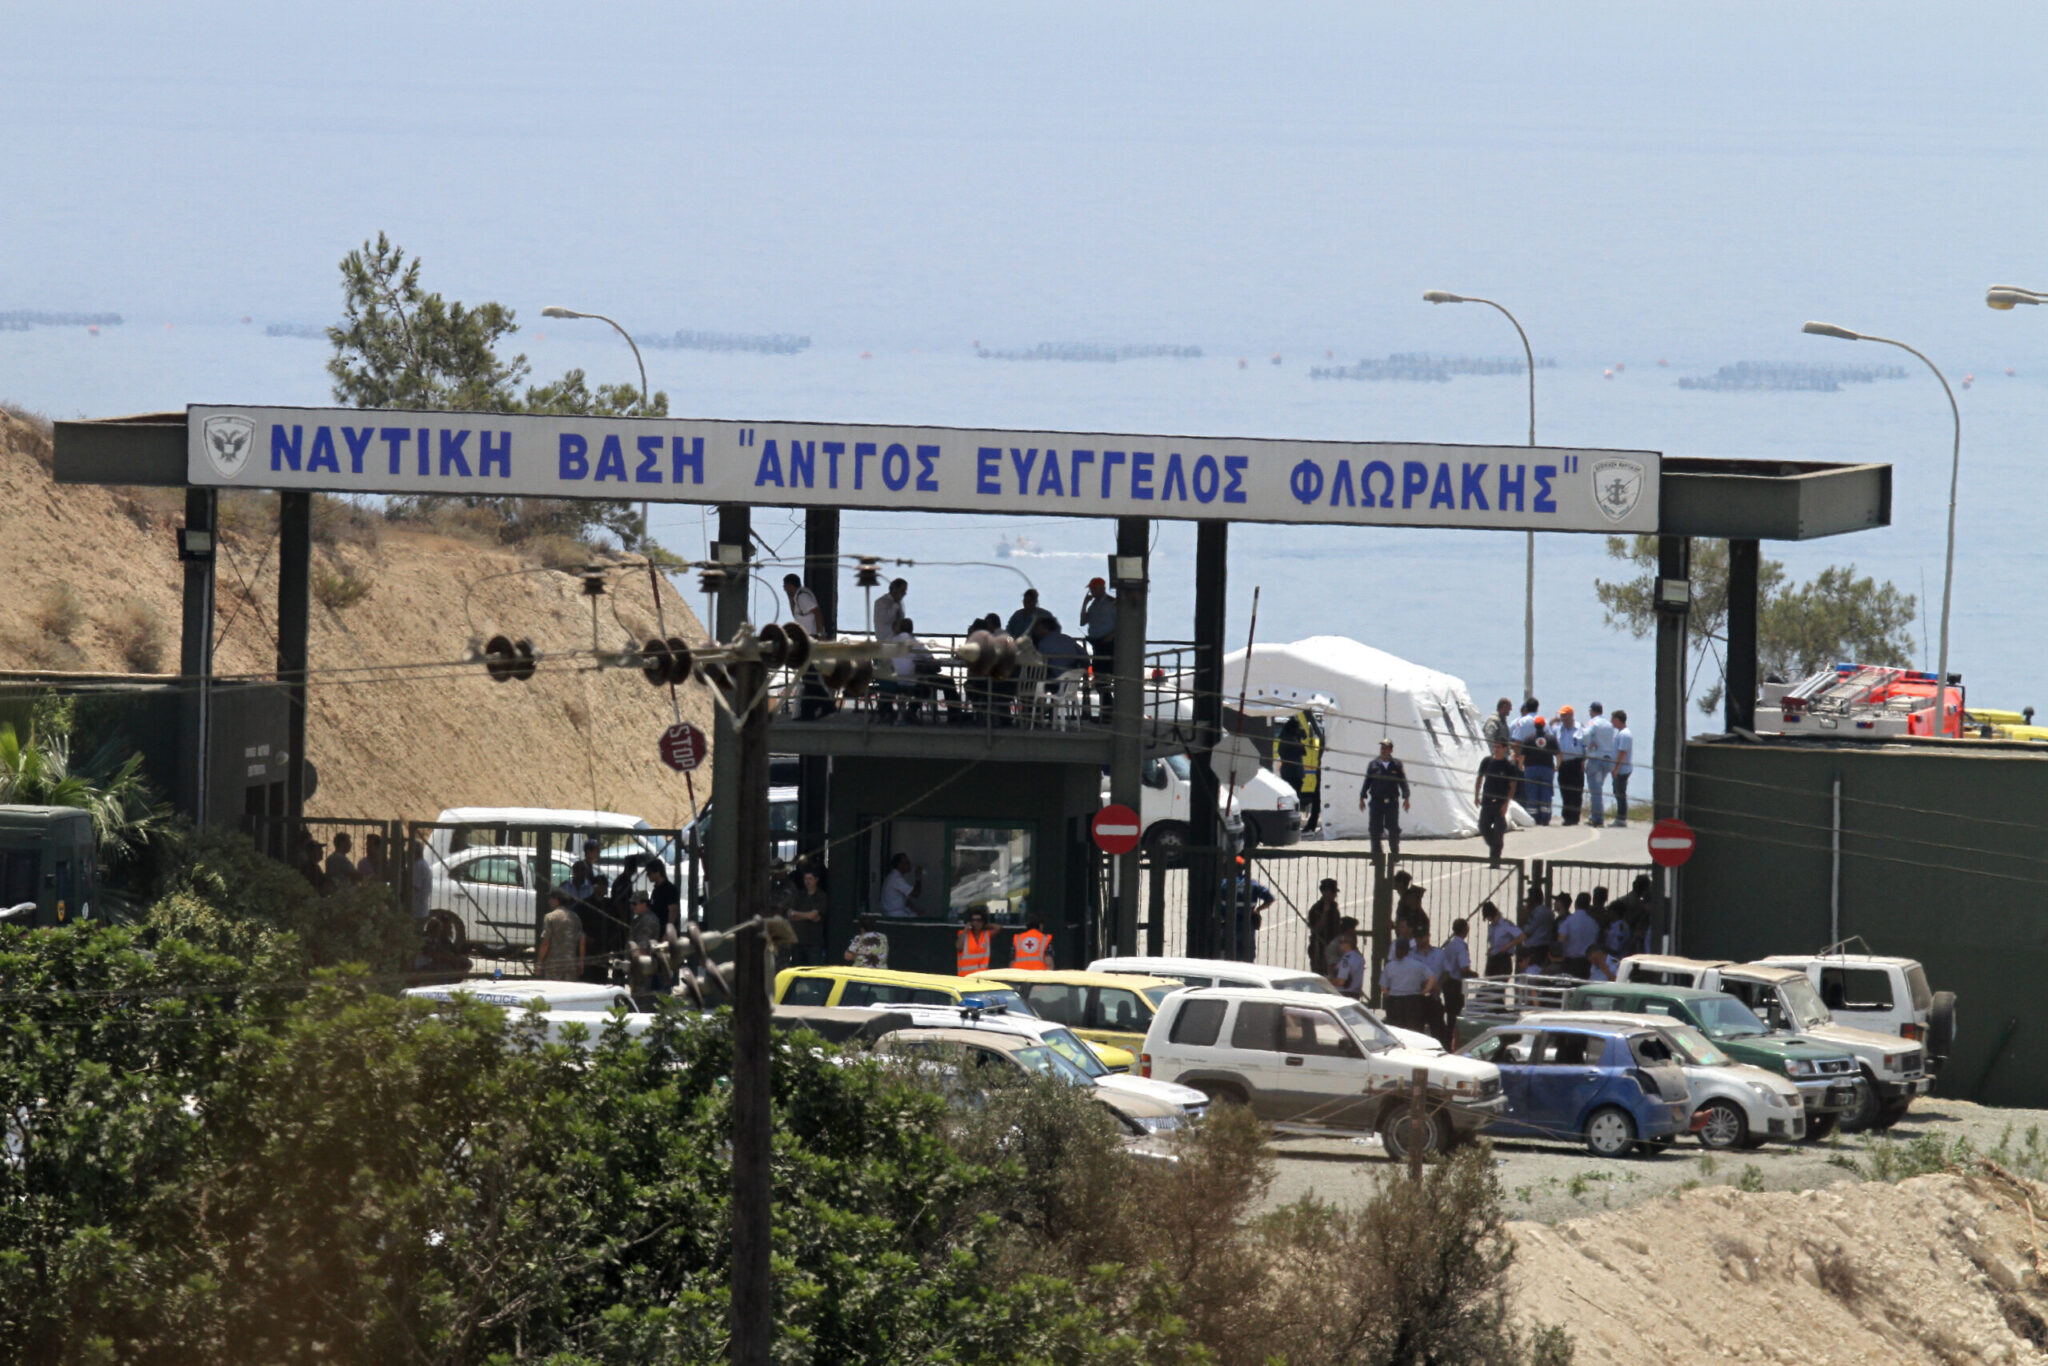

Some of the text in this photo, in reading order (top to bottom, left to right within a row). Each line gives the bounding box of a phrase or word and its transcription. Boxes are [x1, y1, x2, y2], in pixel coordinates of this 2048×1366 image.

[271, 424, 1578, 513] ΝΑΥΤΙΚΗ ΒΑΣΗ "ΑΝΤΓΟΣ ΕΥΑΓΓΕΛΟΣ ΦΛΩΡΑΚΗΣ"
[669, 725, 697, 768] STOP
[476, 993, 518, 1004] POLICE
